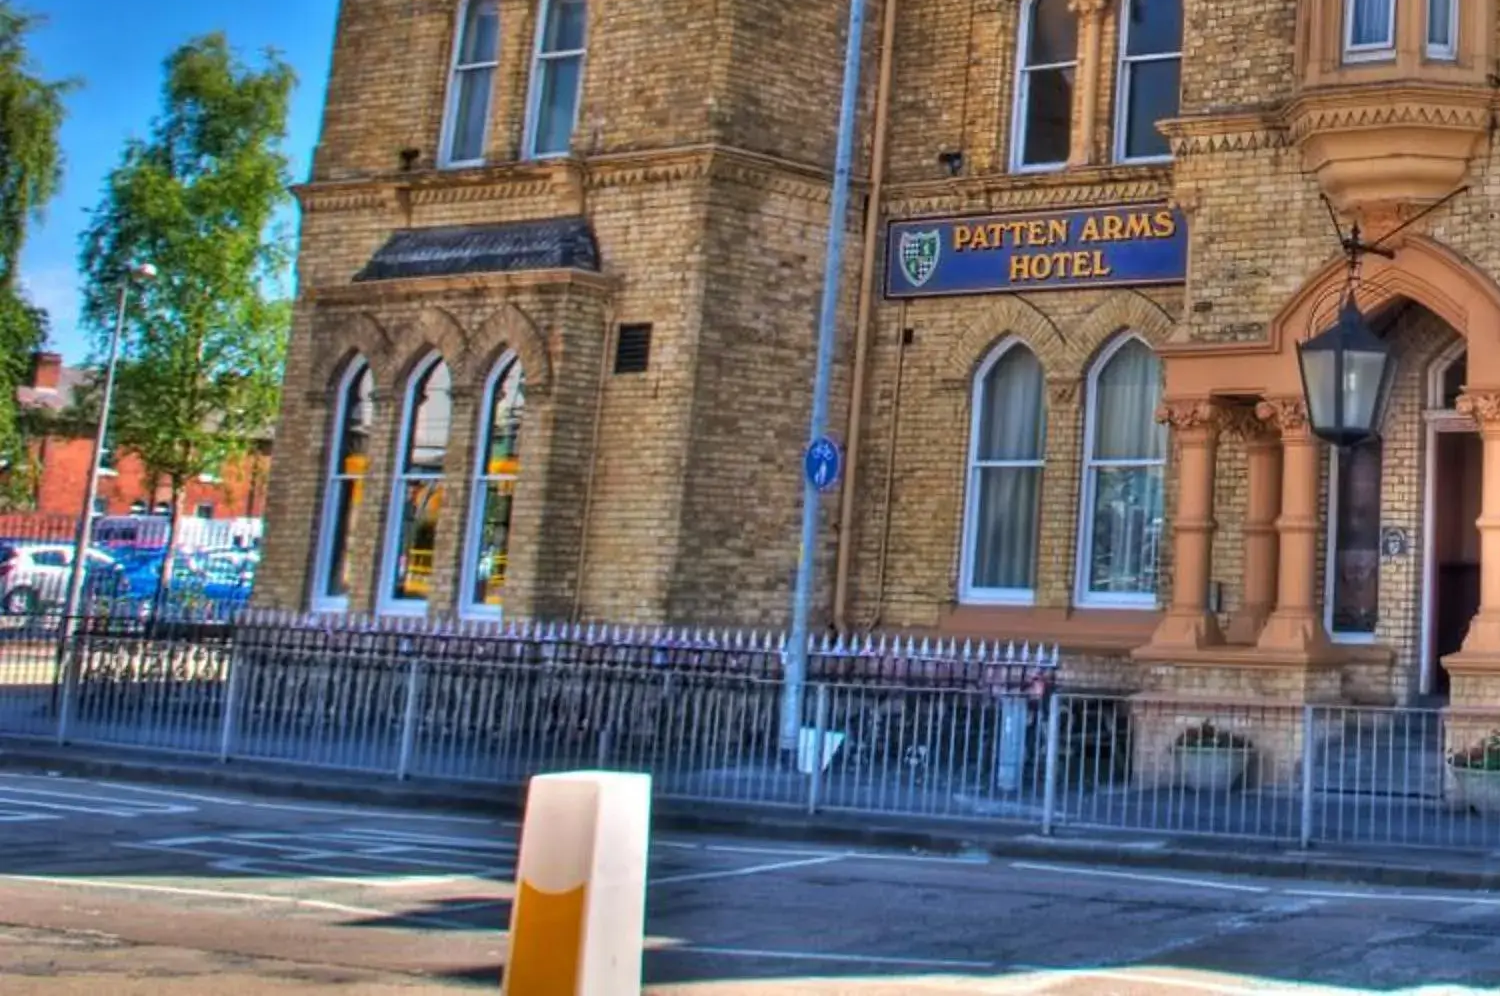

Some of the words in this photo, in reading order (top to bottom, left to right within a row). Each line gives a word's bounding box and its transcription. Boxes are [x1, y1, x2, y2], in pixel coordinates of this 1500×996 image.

[953, 219, 1067, 251] PATTEN
[1080, 210, 1176, 242] ARMS
[1009, 251, 1111, 280] HOTEL
